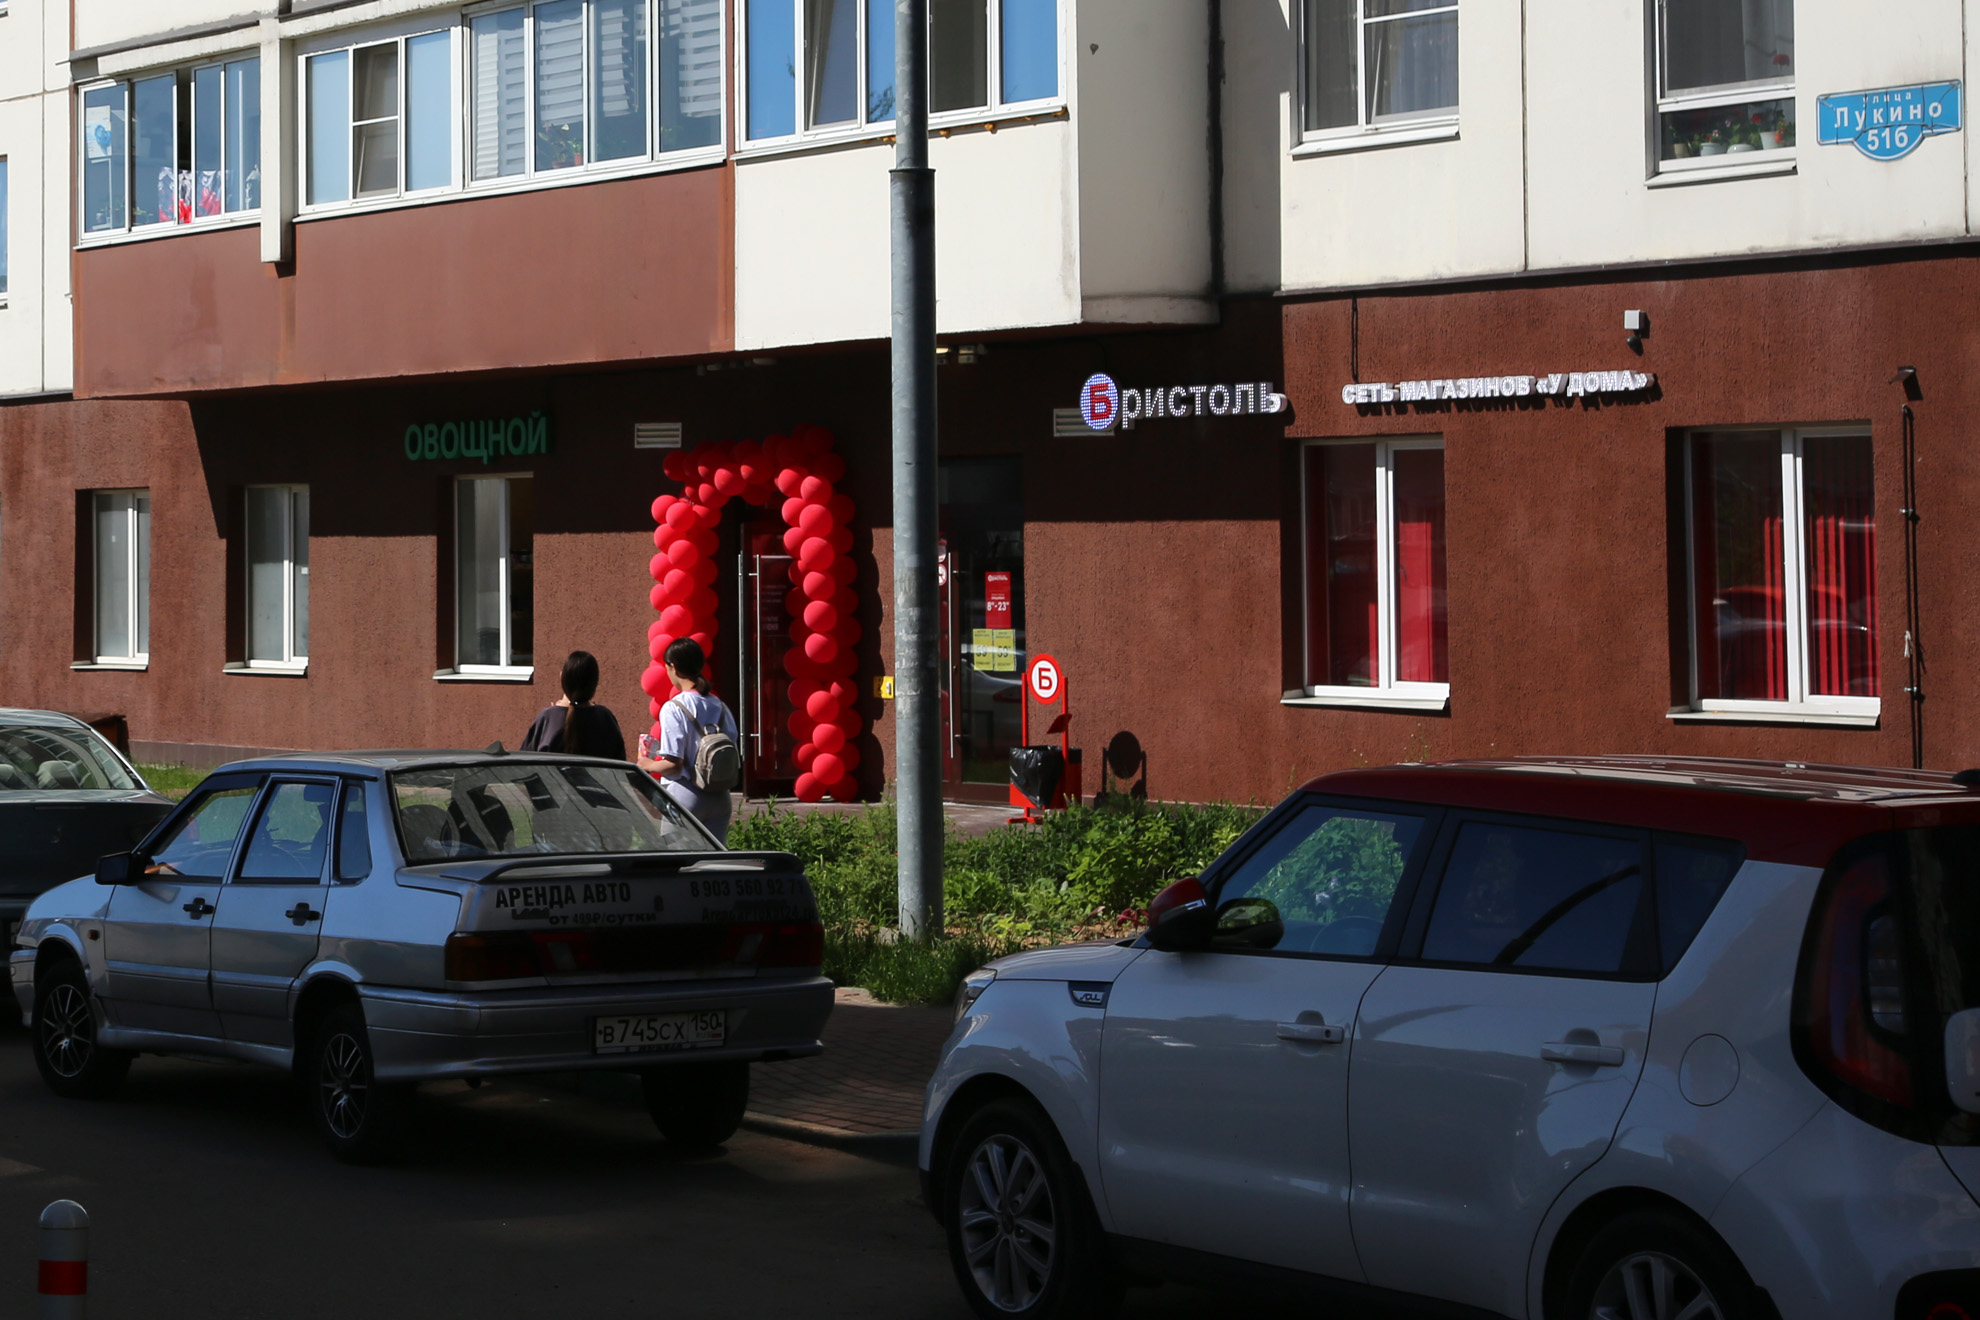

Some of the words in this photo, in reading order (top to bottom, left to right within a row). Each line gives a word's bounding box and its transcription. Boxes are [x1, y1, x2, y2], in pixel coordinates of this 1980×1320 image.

[1863, 91, 1913, 107] улица
[1834, 102, 1943, 131] Лукино
[1083, 375, 1287, 431] Бристоль
[1342, 382, 1396, 405] СЕТЬ
[1400, 376, 1532, 402] МАГАЗИНОВ
[405, 410, 547, 465] ОВОЩНОЙ
[1038, 667, 1053, 691] Б
[496, 884, 577, 908] АРЕНДА
[584, 882, 631, 904] АВТО
[690, 881, 699, 898] 8
[703, 880, 731, 897] 903
[736, 879, 763, 896] 560
[767, 879, 784, 895] 92
[690, 1012, 719, 1032] 150
